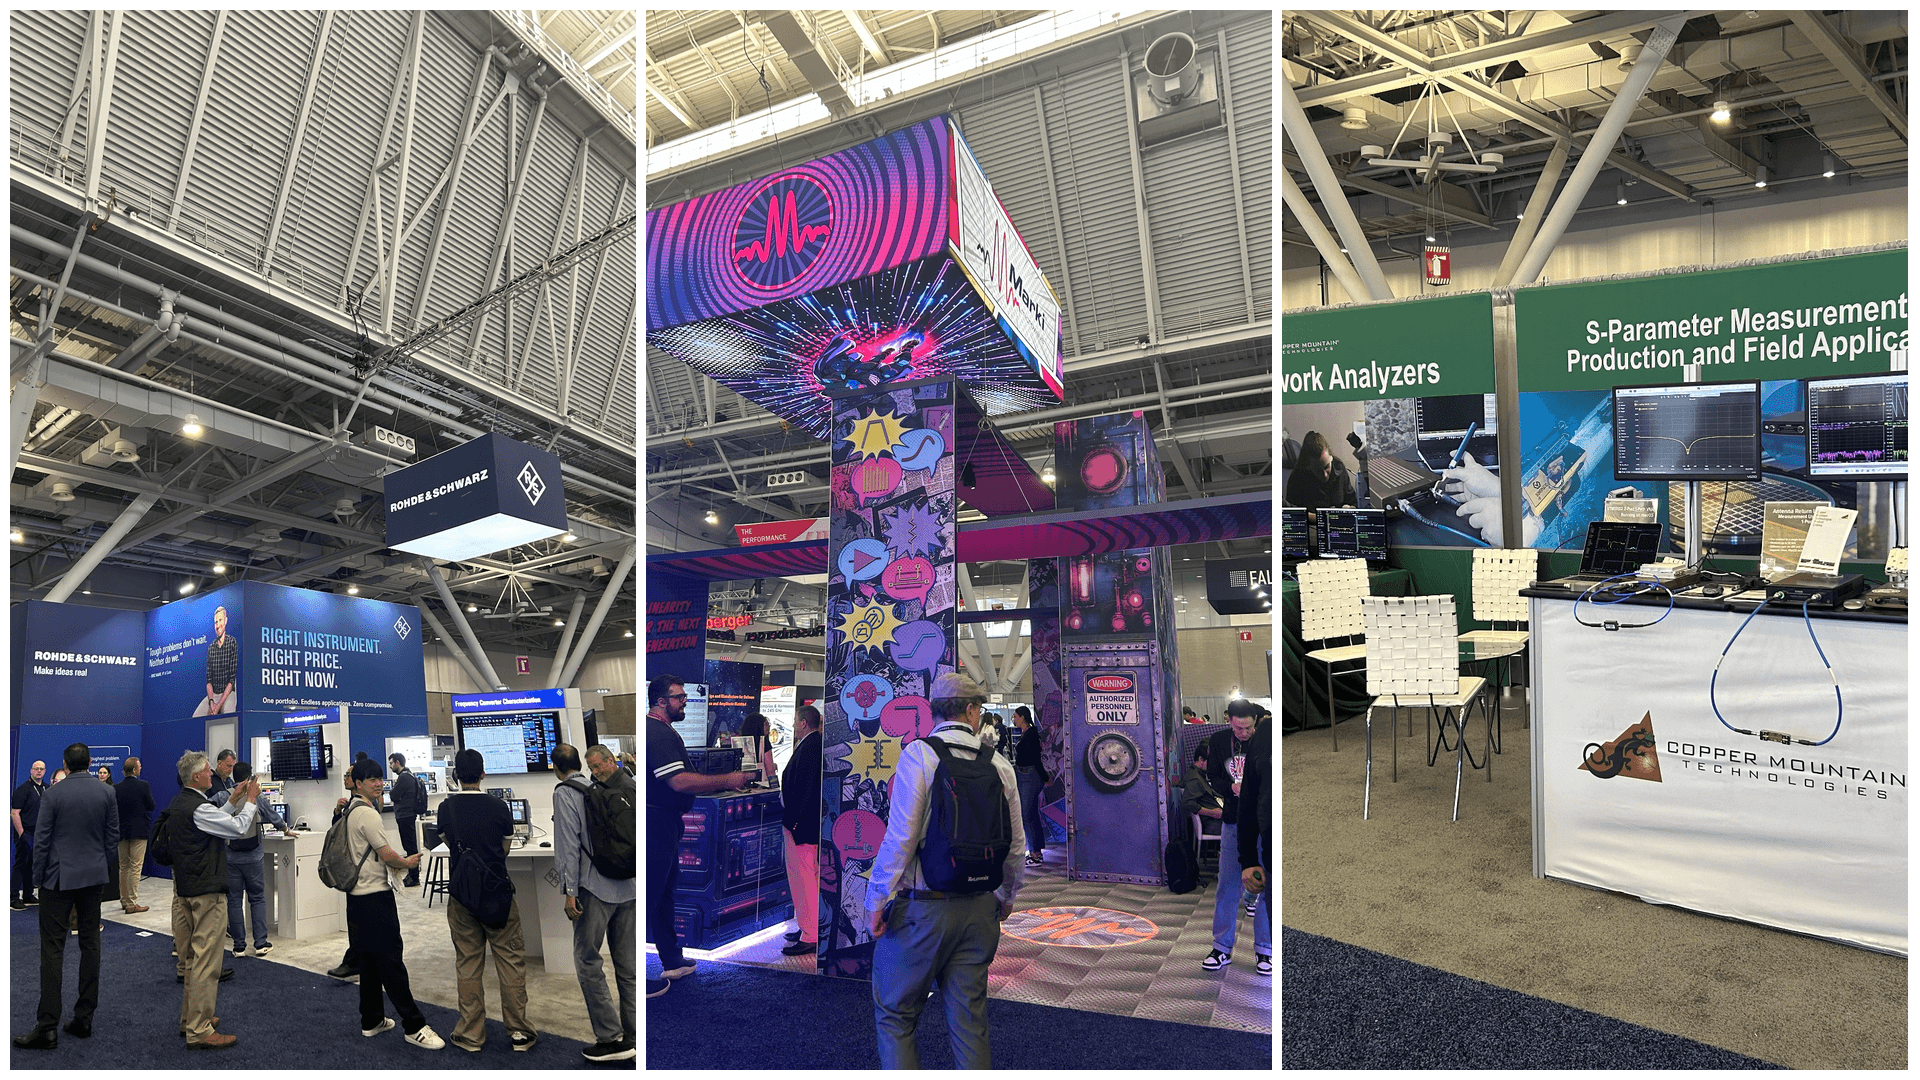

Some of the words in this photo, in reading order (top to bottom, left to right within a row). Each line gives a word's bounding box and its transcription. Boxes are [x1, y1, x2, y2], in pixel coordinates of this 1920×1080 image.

[1009, 263, 1045, 331] Marki
[1586, 314, 1723, 344] S-Parameter
[1730, 293, 1908, 334] Measurement
[1567, 343, 1685, 373] Production
[1692, 339, 1736, 366] and
[1744, 332, 1804, 363] Field
[1329, 360, 1441, 395] Analyzers
[390, 468, 489, 512] ROHDE&SCHWARZ
[742, 534, 787, 544] PERFORMANCE
[1249, 569, 1272, 587] FAL
[657, 619, 675, 632] THE
[678, 617, 702, 631] NEXT
[261, 626, 301, 646] RIGHT
[304, 631, 382, 655] INSTRUMENT.
[34, 651, 137, 666] ROHDE&SCHWARZ
[261, 647, 301, 666] RIGHT
[304, 651, 343, 669] PRICE.
[33, 666, 54, 676] Make
[55, 666, 74, 676] ideas
[75, 668, 88, 677] real
[261, 668, 301, 687] RIGHT
[305, 671, 338, 689] NOW.
[1092, 679, 1128, 688] WARNING
[276, 697, 300, 705] portfolio.
[322, 699, 352, 708] applications.
[1097, 710, 1127, 722] ONLY
[1667, 741, 1757, 765] COPPER
[1769, 755, 1906, 788] MOUNTAIN
[1682, 759, 1888, 800] TECHNOLOGIES
